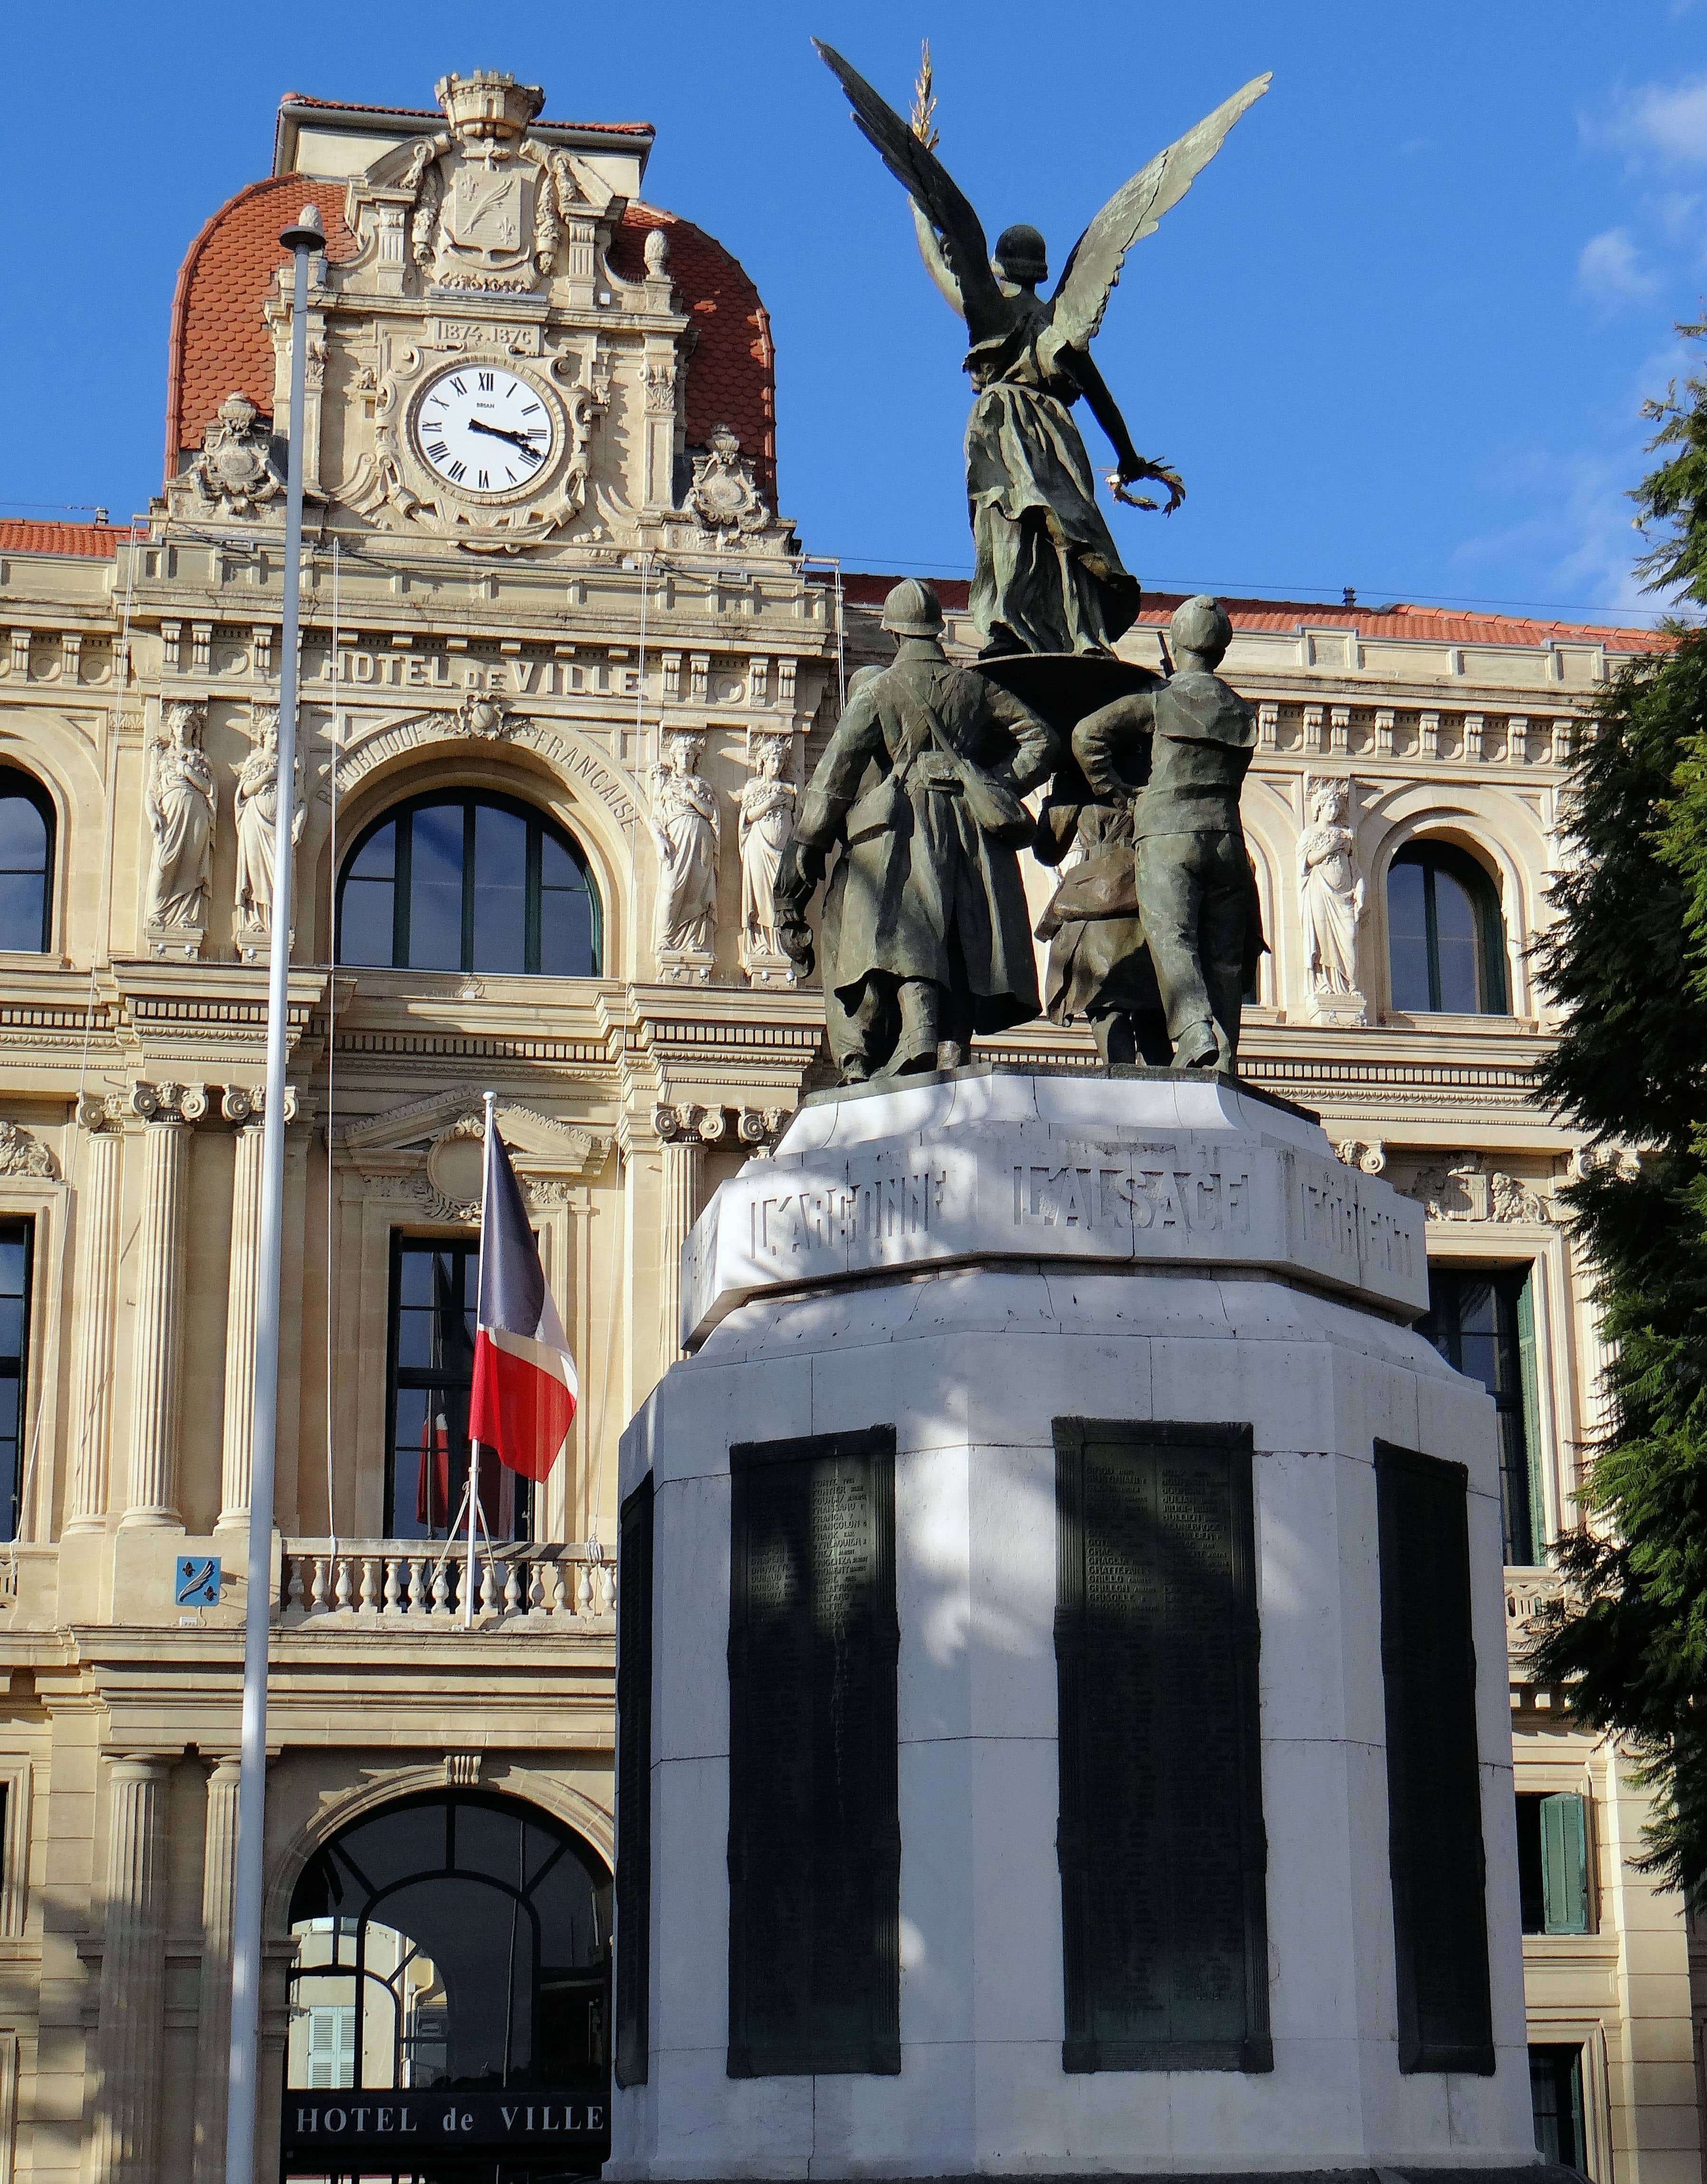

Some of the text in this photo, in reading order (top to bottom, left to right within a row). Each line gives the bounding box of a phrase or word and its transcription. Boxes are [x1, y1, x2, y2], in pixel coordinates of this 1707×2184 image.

[449, 377, 468, 397] XI
[478, 372, 494, 392] XII
[521, 403, 540, 416] II
[479, 470, 490, 489] VI
[323, 651, 452, 687] HOTEL
[506, 660, 641, 697] VILLE
[296, 2106, 604, 2133] HOTEL de VILLE
